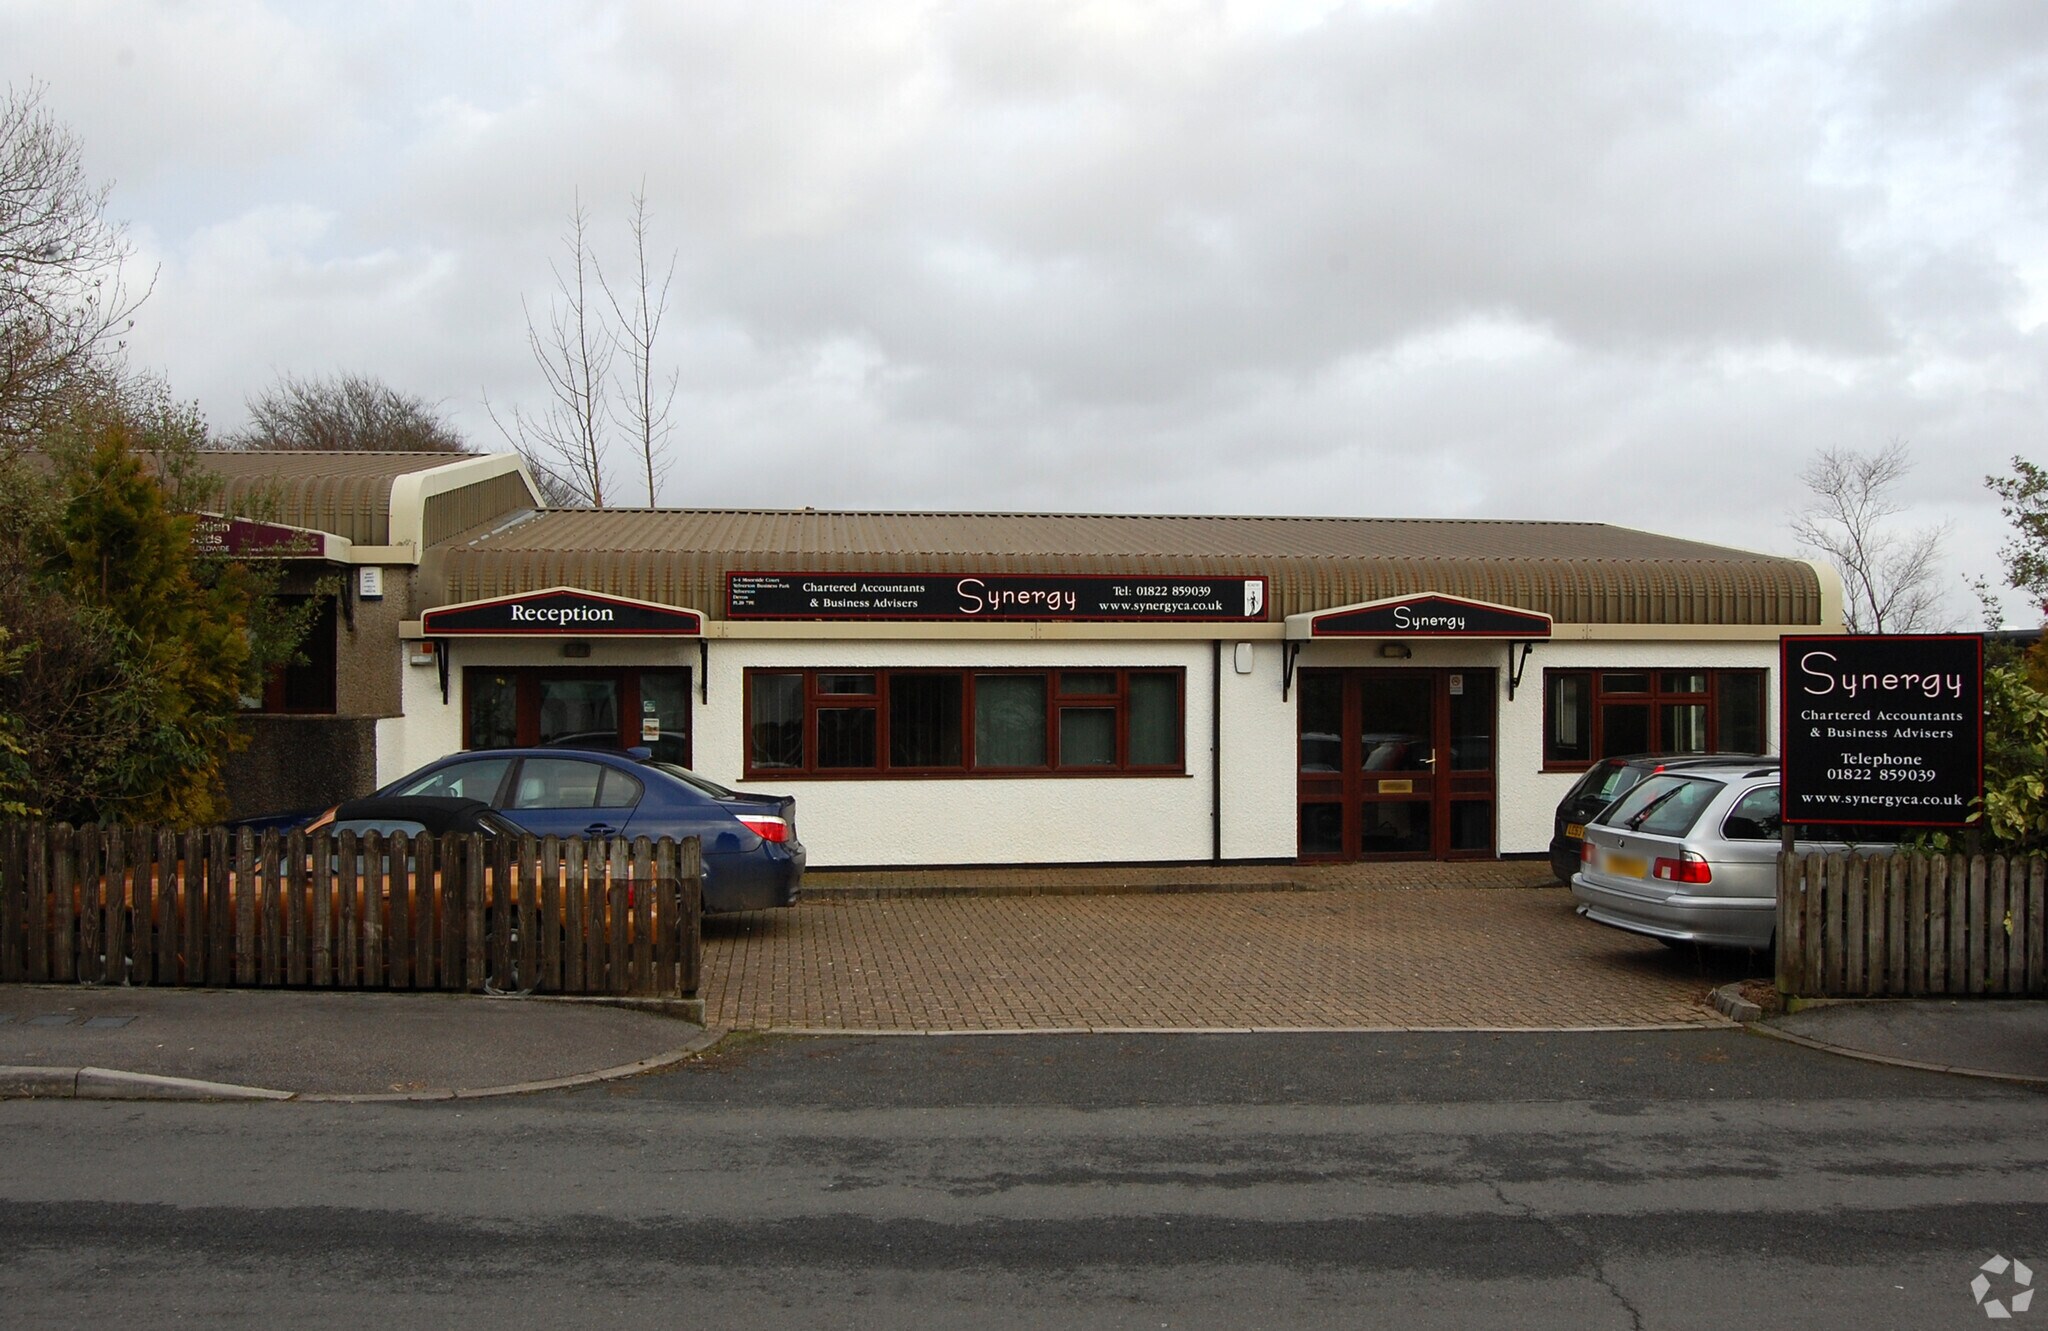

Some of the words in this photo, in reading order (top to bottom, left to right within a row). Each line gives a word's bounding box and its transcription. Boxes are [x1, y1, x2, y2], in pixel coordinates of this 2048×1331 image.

[802, 582, 857, 593] Chartered
[860, 583, 926, 593] Accountants
[1112, 586, 1132, 596] Tel:
[1136, 586, 1168, 596] 01822
[1172, 586, 1211, 597] 859039
[809, 598, 819, 608] &
[823, 598, 870, 608] Business
[873, 598, 918, 608] Advisers
[956, 578, 1077, 614] Synergy
[1099, 600, 1223, 613] www.synergyca.co.uk
[511, 604, 614, 626] Reception
[1393, 605, 1466, 631] Synergy
[1800, 651, 1962, 698] Synergy
[1801, 710, 1871, 721] Chartered
[1876, 711, 1963, 722] Accountants
[1810, 727, 1821, 738] &
[1827, 727, 1888, 738] Business
[1893, 728, 1954, 739] Advisers
[1841, 753, 1922, 768] Telephone
[1827, 768, 1872, 781] 01822
[1879, 769, 1937, 782] 859039
[1801, 794, 1963, 808] www.synergyca.co.uk
